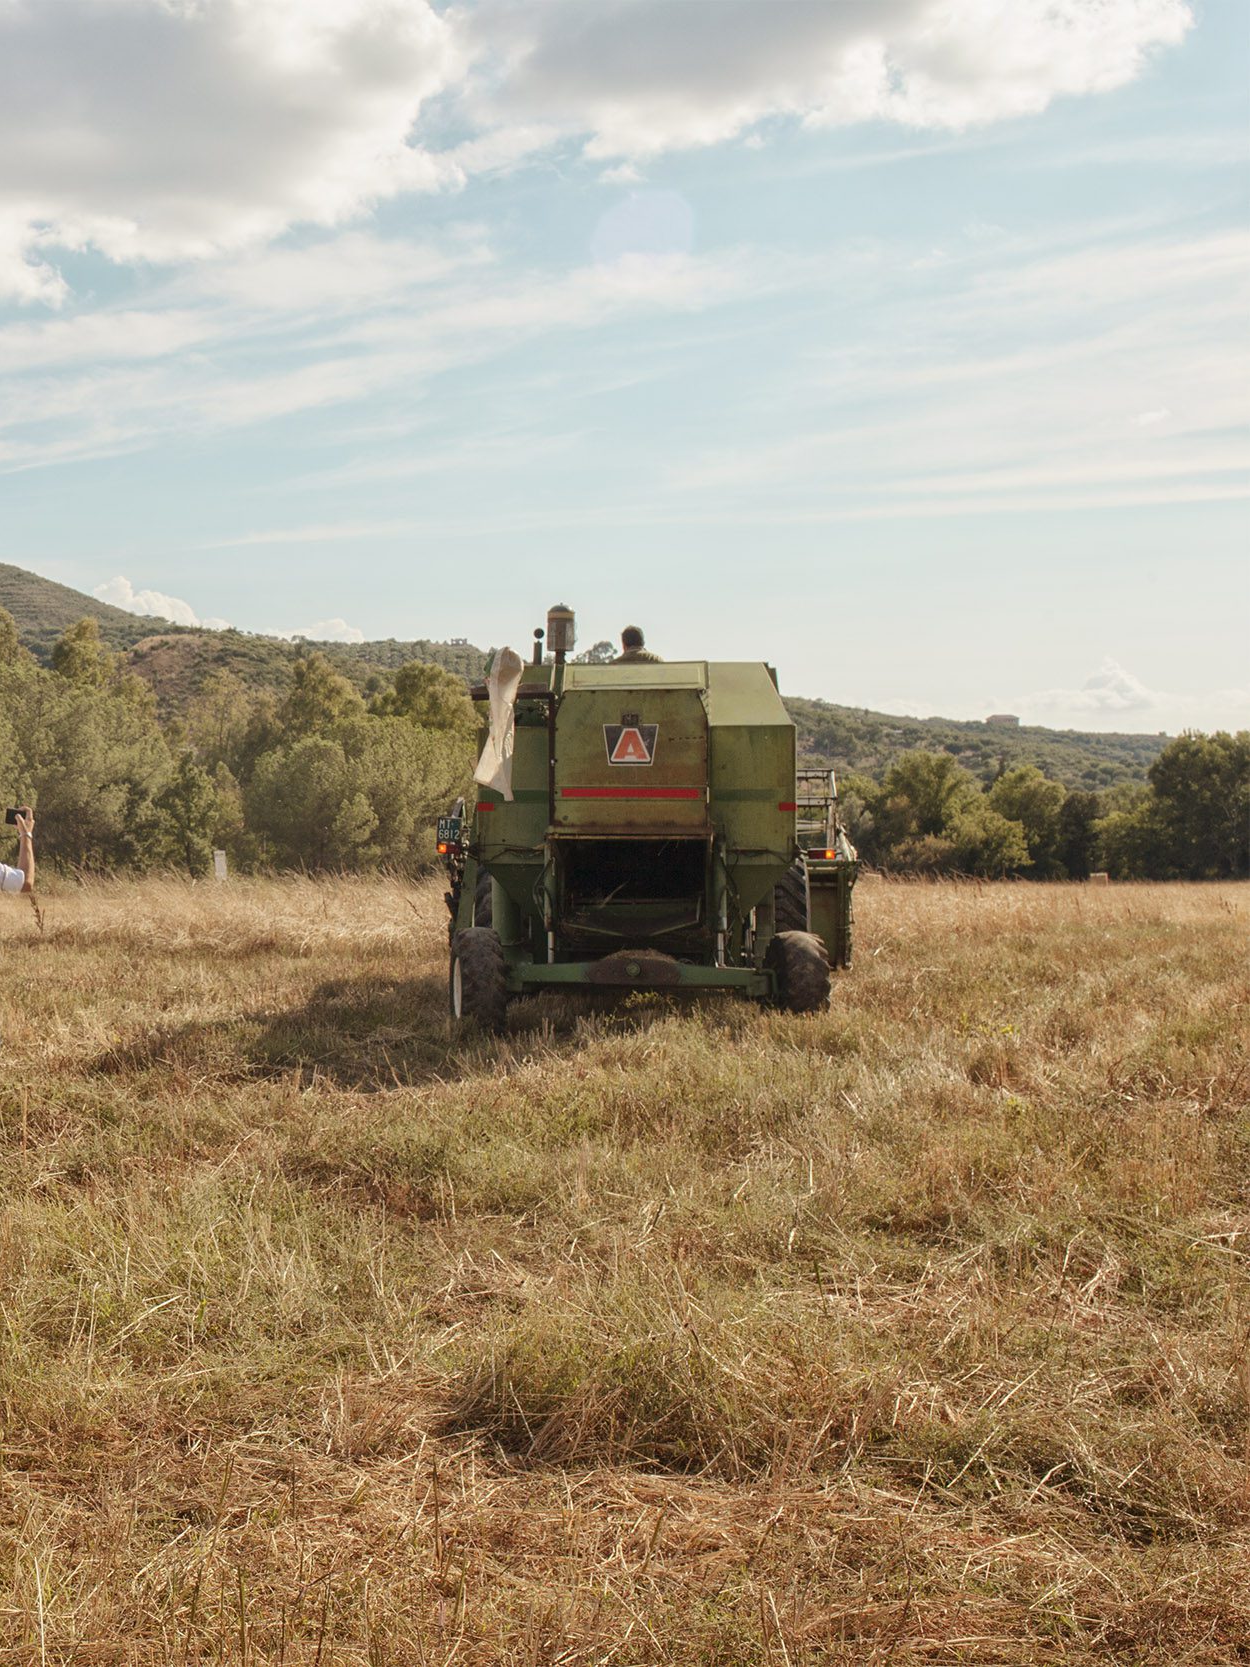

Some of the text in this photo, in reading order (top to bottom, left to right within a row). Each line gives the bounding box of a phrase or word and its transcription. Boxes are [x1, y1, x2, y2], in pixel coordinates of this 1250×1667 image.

[611, 728, 650, 762] A
[439, 819, 451, 829] MT
[439, 829, 460, 840] 6812
